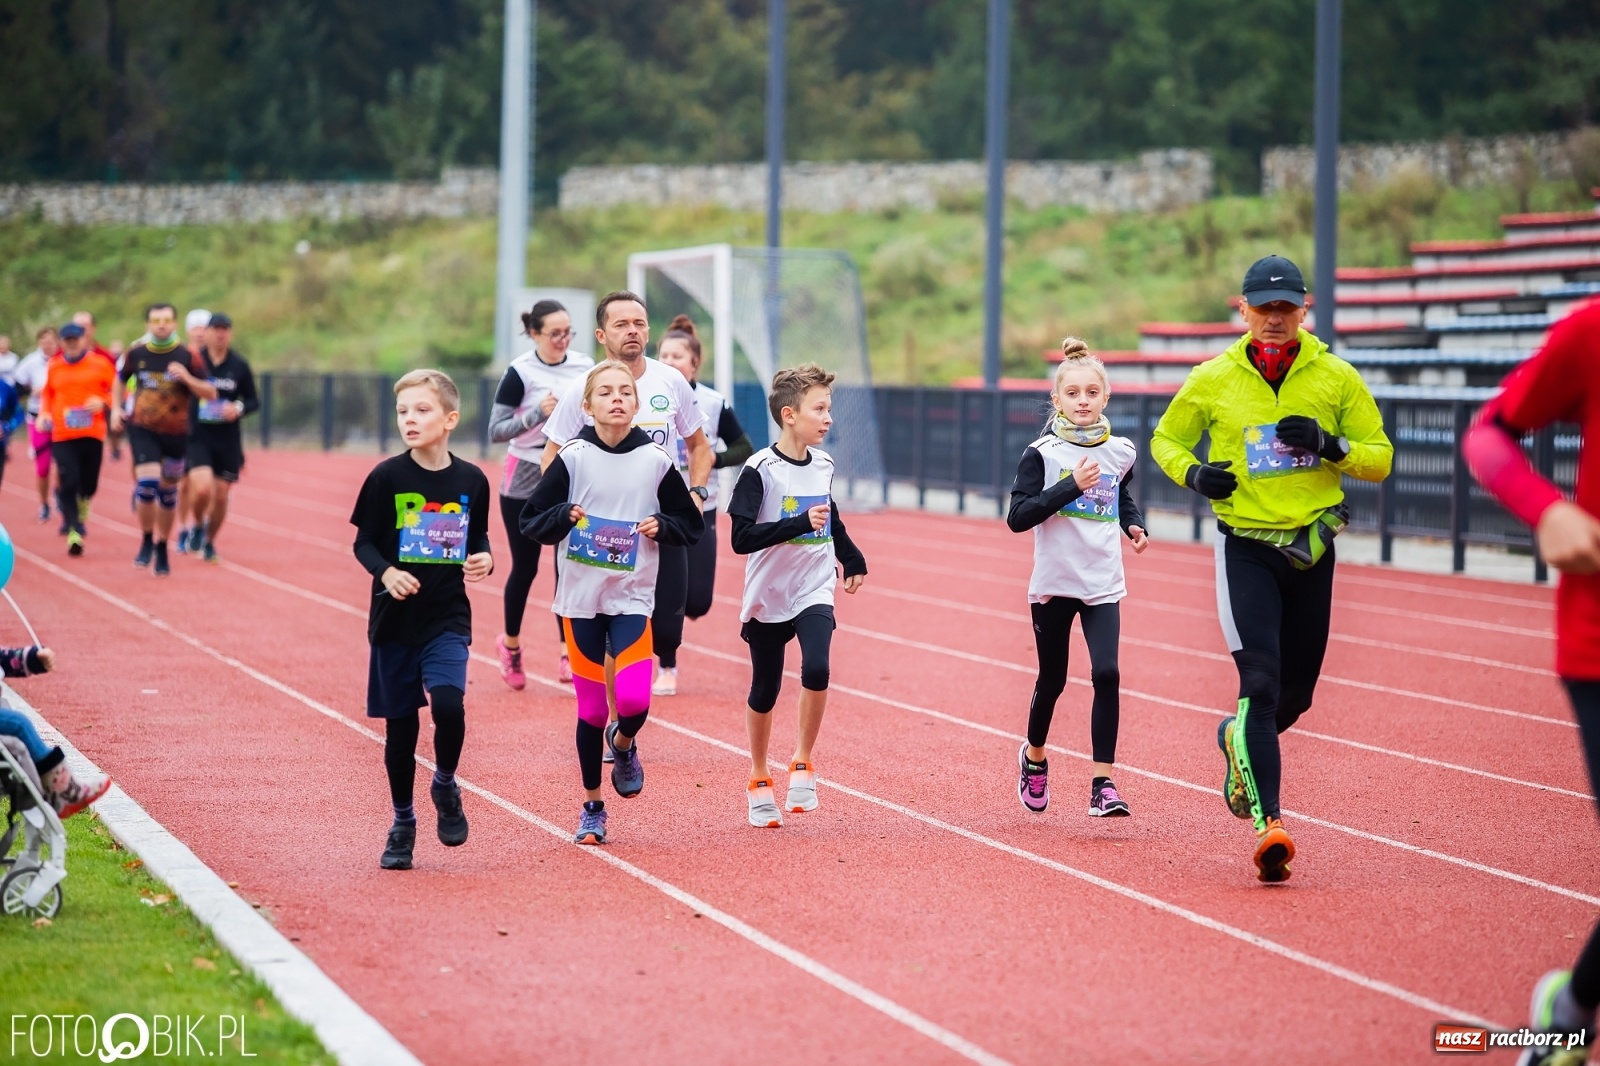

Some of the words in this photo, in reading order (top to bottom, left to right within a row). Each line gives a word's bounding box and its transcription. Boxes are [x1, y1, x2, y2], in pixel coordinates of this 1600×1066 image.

[1291, 455, 1315, 468] 229
[1094, 504, 1114, 516] 096
[579, 530, 593, 540] BIEG
[595, 534, 607, 542] DLA
[442, 547, 462, 559] 134
[606, 552, 630, 564] 026
